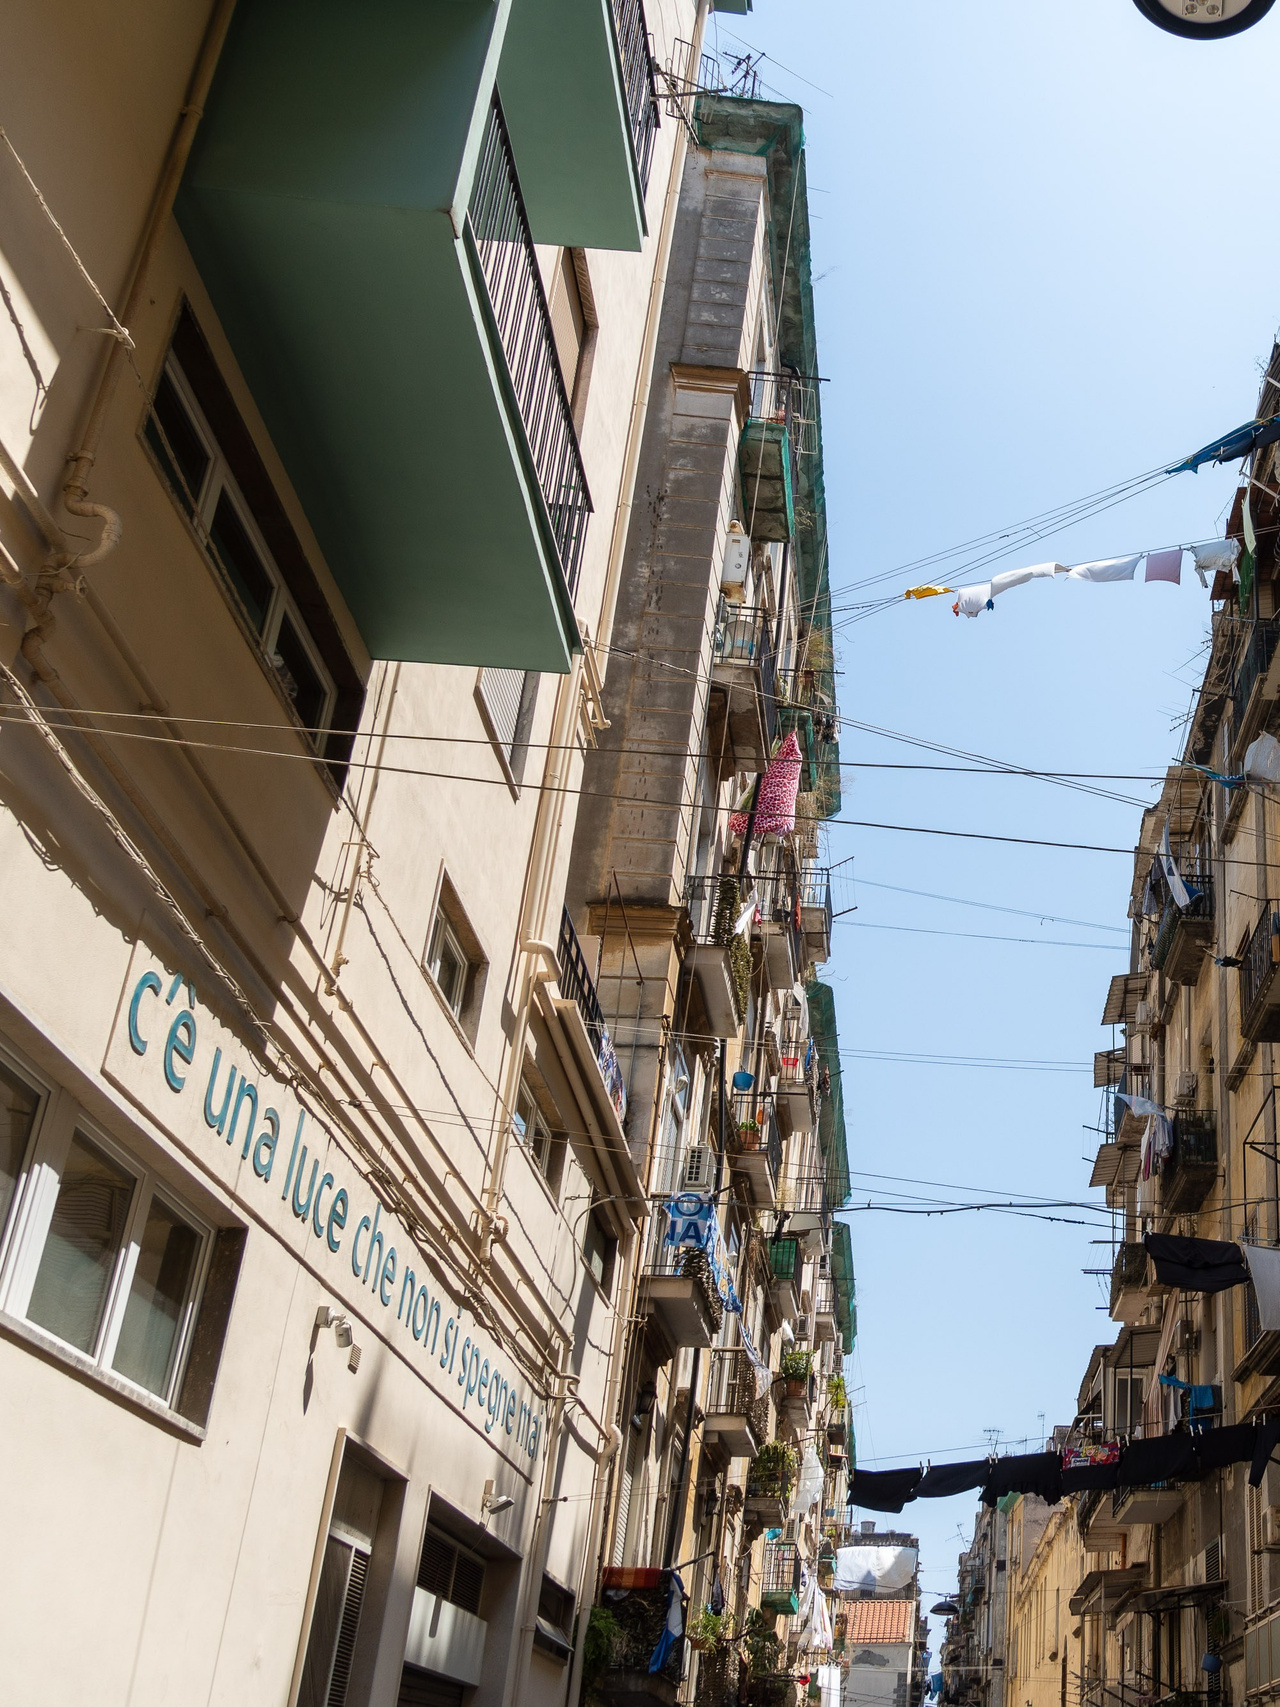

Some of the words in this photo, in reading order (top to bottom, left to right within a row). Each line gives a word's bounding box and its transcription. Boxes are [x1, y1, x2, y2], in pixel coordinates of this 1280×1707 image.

[128, 970, 197, 1093] c'è
[204, 1046, 279, 1183] una
[281, 1107, 348, 1253] luce
[352, 1200, 397, 1307] che
[397, 1264, 441, 1356] non
[440, 1306, 462, 1374] si
[458, 1336, 516, 1434] spegne
[516, 1400, 545, 1462] mai
